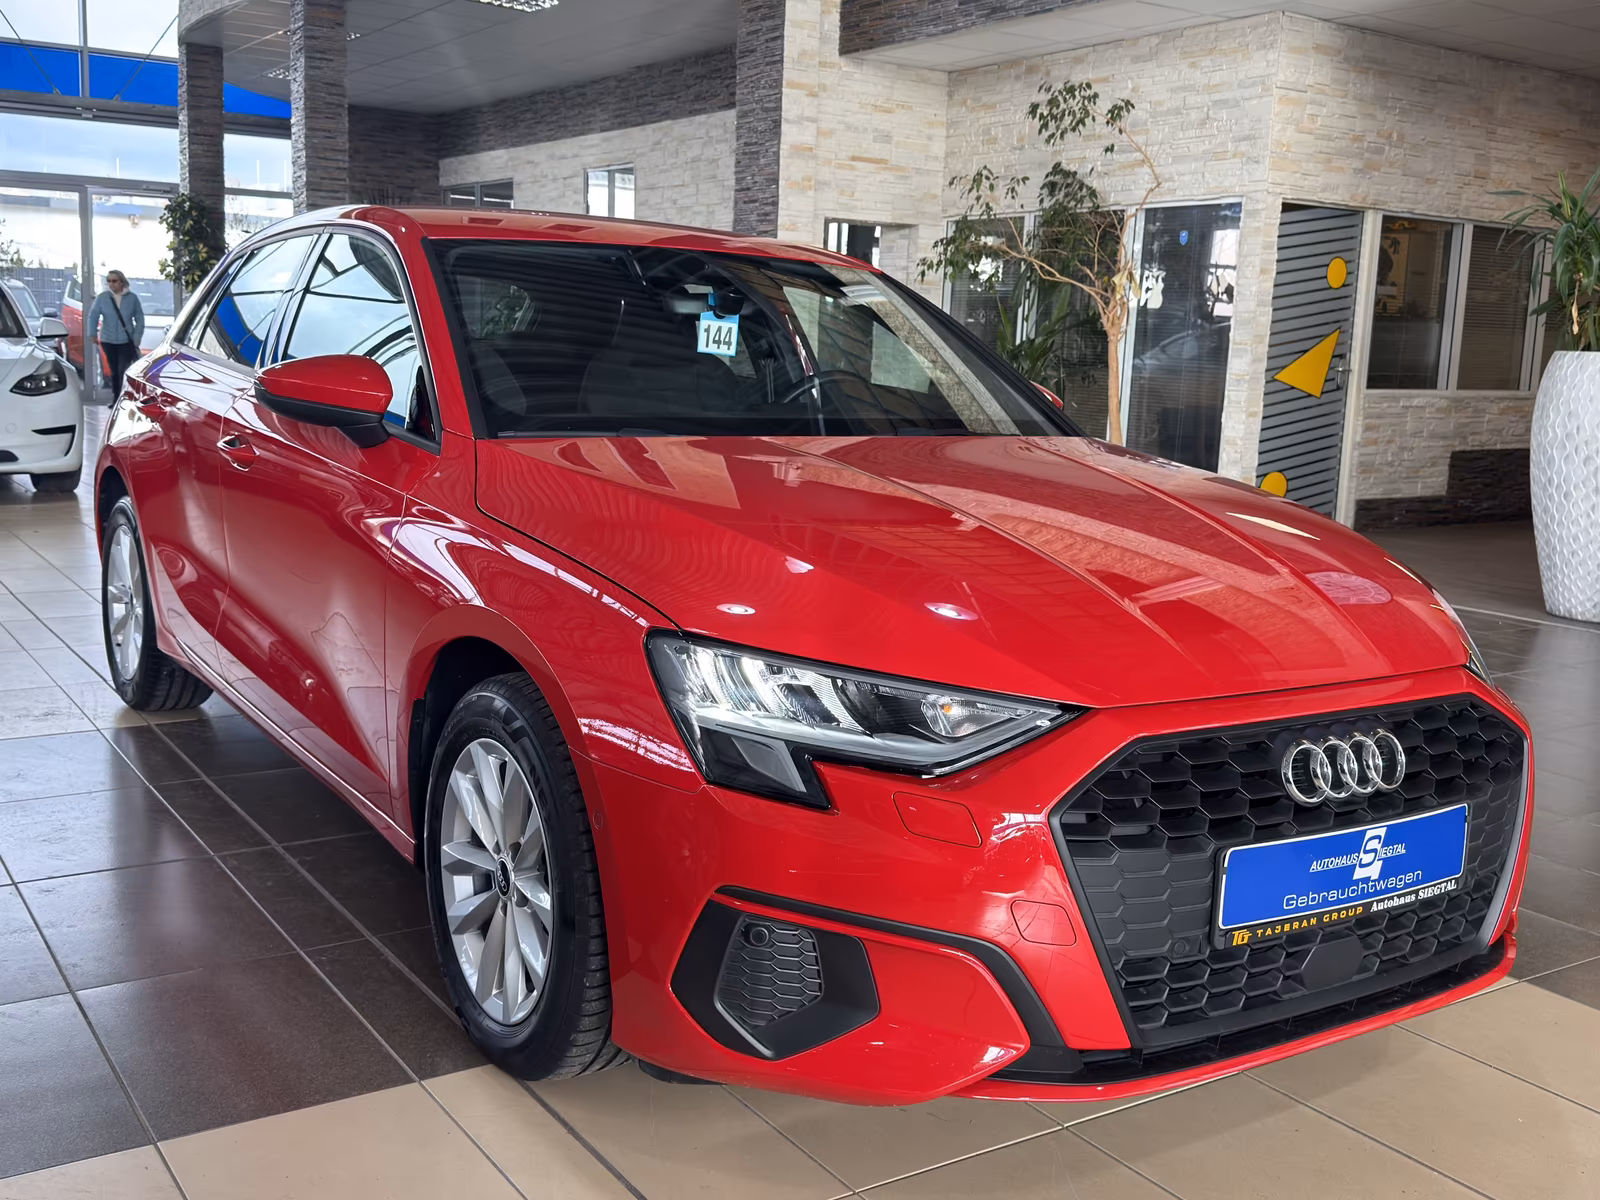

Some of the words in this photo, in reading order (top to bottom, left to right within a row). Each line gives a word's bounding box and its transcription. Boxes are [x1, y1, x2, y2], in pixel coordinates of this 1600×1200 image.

[704, 324, 733, 351] 144
[1309, 853, 1360, 872] AUTOHAUS
[1283, 870, 1422, 909] Gebrauchtwagen
[1370, 894, 1416, 912] Autohaus
[1417, 879, 1457, 900] SIEGTAL
[1256, 917, 1317, 938] TAJERAN
[1323, 906, 1364, 923] GROUP
